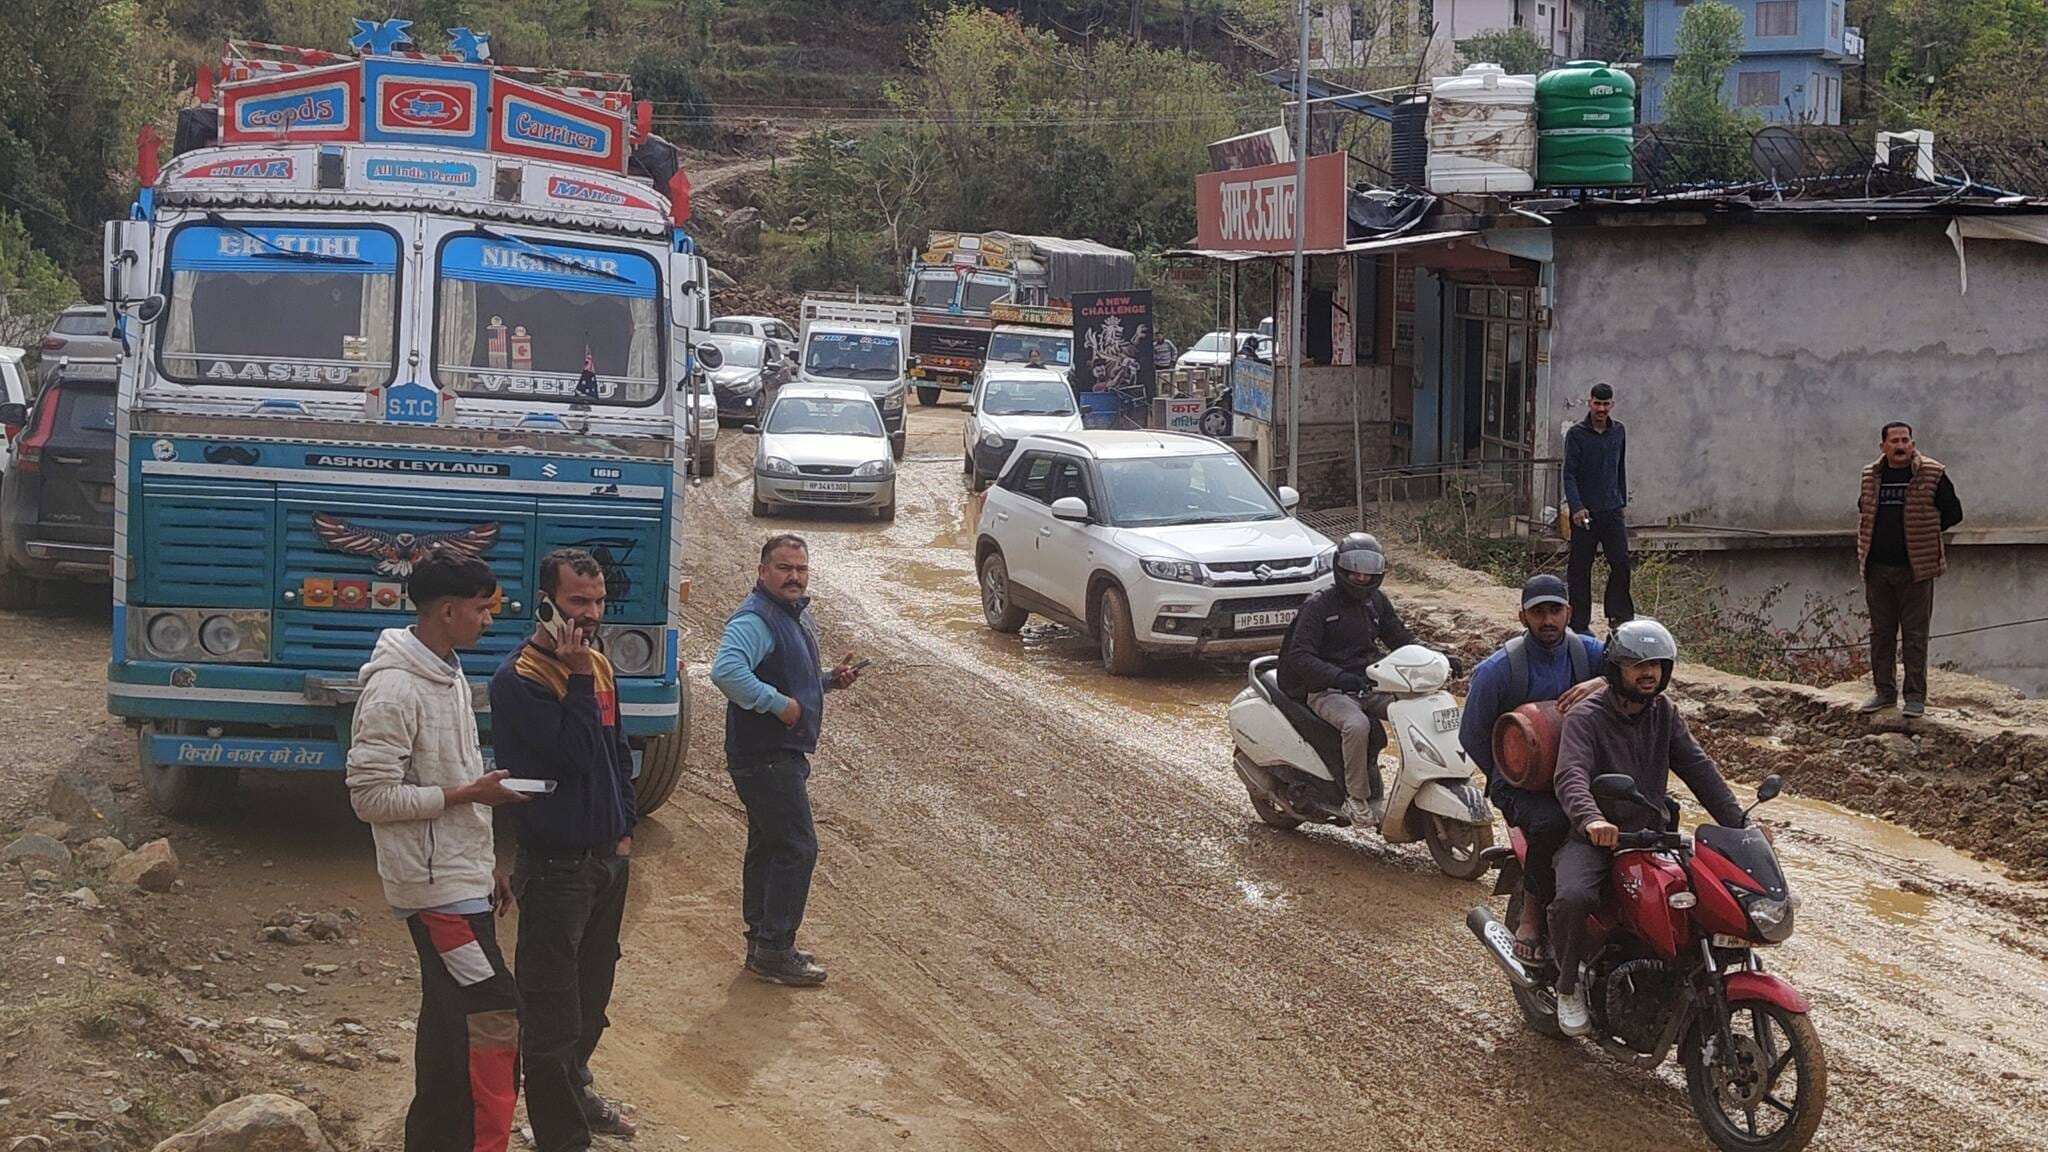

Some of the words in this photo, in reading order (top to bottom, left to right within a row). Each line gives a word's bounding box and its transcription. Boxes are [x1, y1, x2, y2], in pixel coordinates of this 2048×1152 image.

[1589, 85, 1613, 95] VECTUS
[249, 96, 334, 126] Goods
[374, 165, 392, 176] All
[395, 167, 427, 179] India
[431, 170, 471, 183] Permit
[1219, 181, 1251, 240] अमर
[1252, 175, 1304, 241] उजाल
[218, 234, 268, 255] EK
[1081, 305, 1146, 316] CHALLENGE
[1106, 297, 1131, 306] NEW
[206, 362, 350, 383] AASHU
[1172, 403, 1200, 414] कार
[317, 455, 393, 469] ASHOK
[399, 460, 499, 475] LEYLAND
[1241, 614, 1270, 627] HP58A
[177, 743, 222, 762] किसी
[268, 746, 292, 764] को
[294, 748, 323, 765] तेरा
